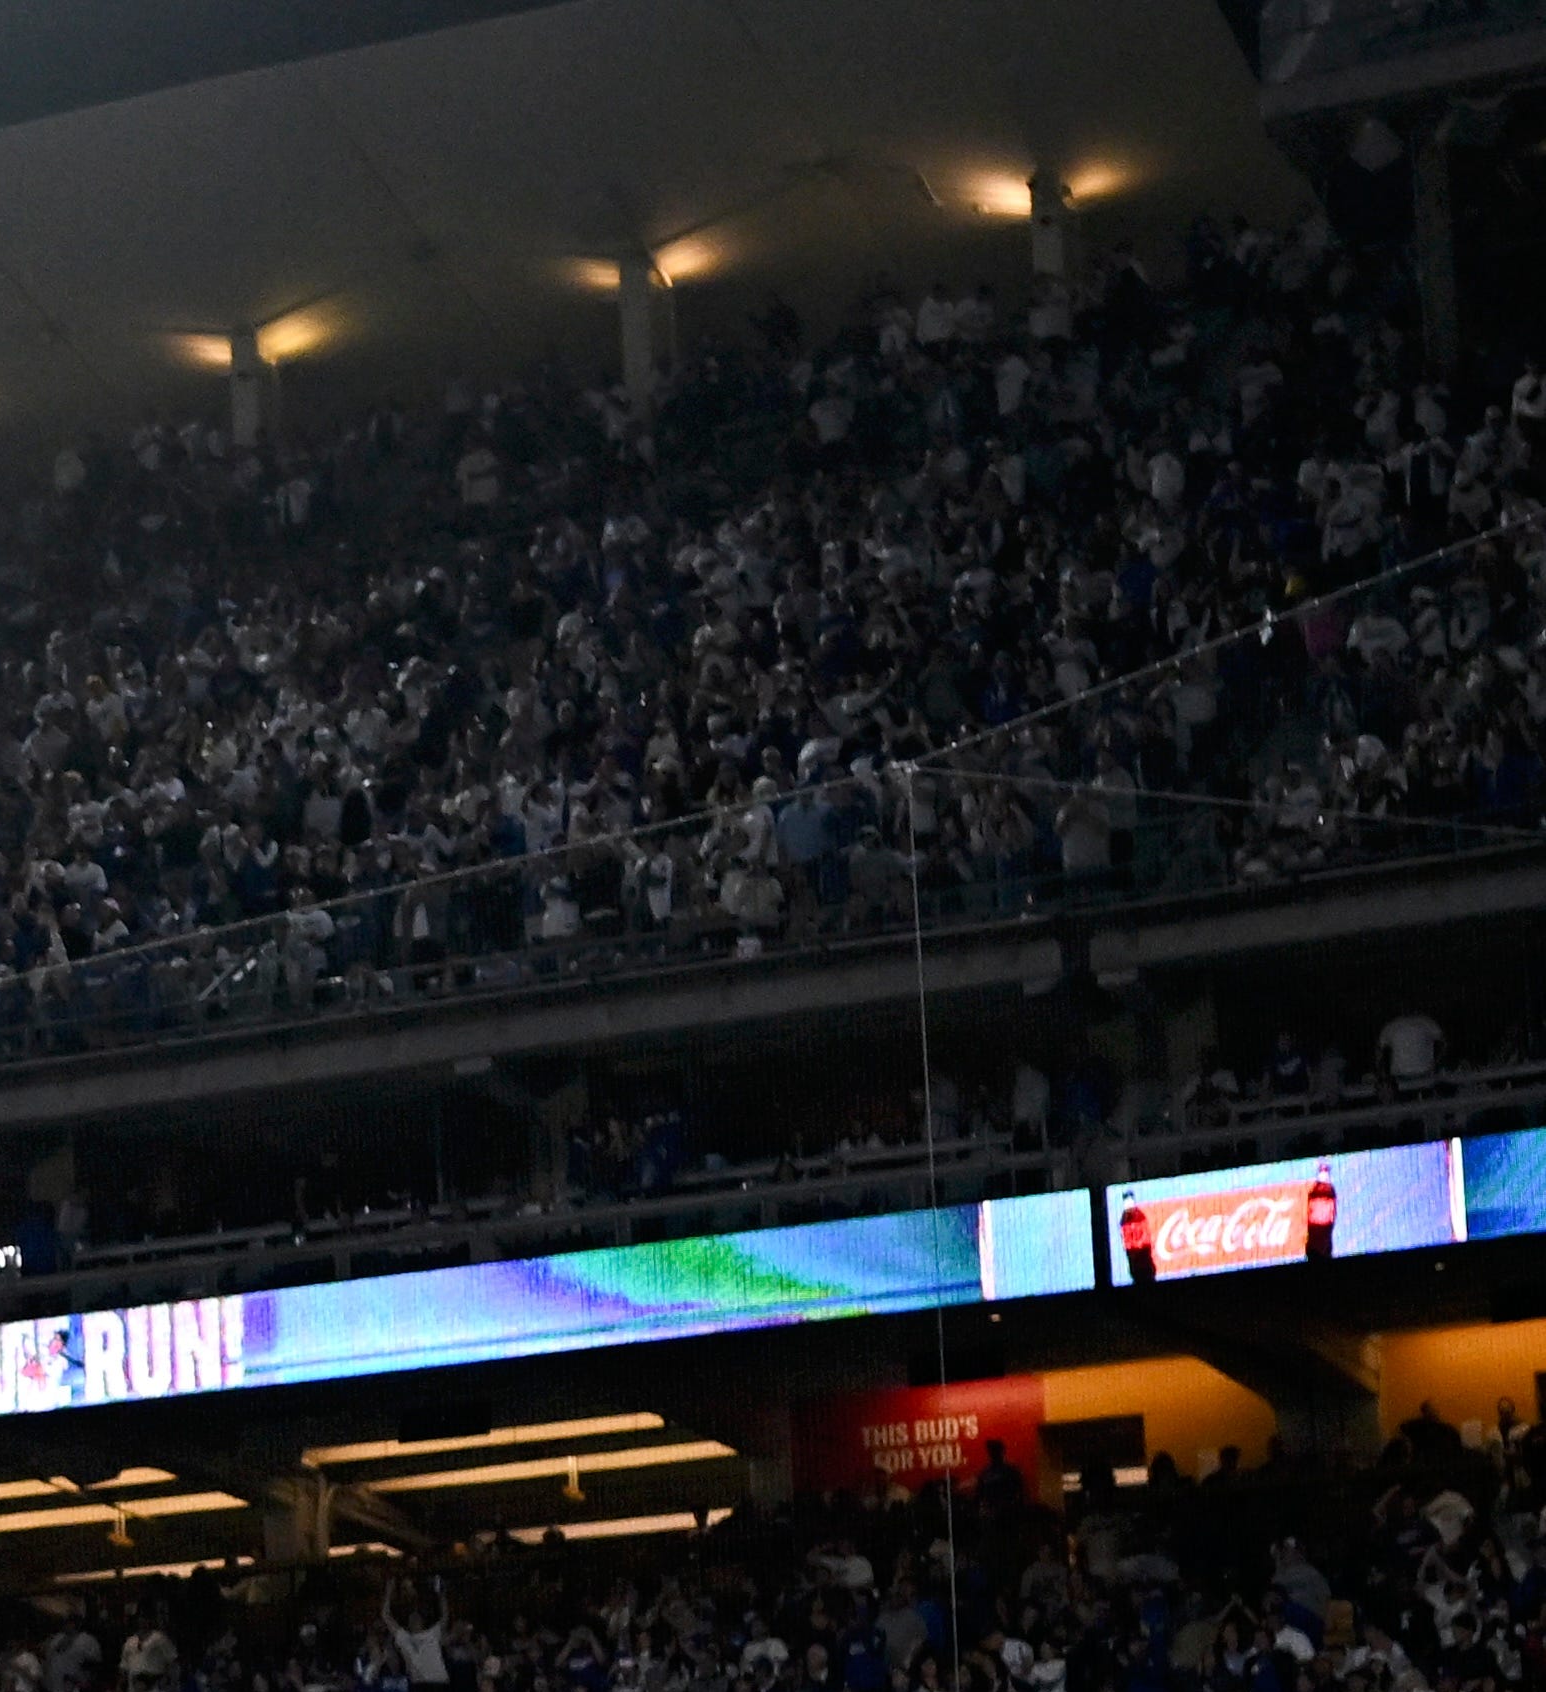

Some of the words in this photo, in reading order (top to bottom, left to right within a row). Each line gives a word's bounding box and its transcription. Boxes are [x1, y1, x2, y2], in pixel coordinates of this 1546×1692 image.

[81, 1294, 245, 1401] RUN!
[862, 1421, 908, 1448] THIS
[914, 1414, 980, 1442] BUD'S
[918, 1443, 968, 1471] YOU.
